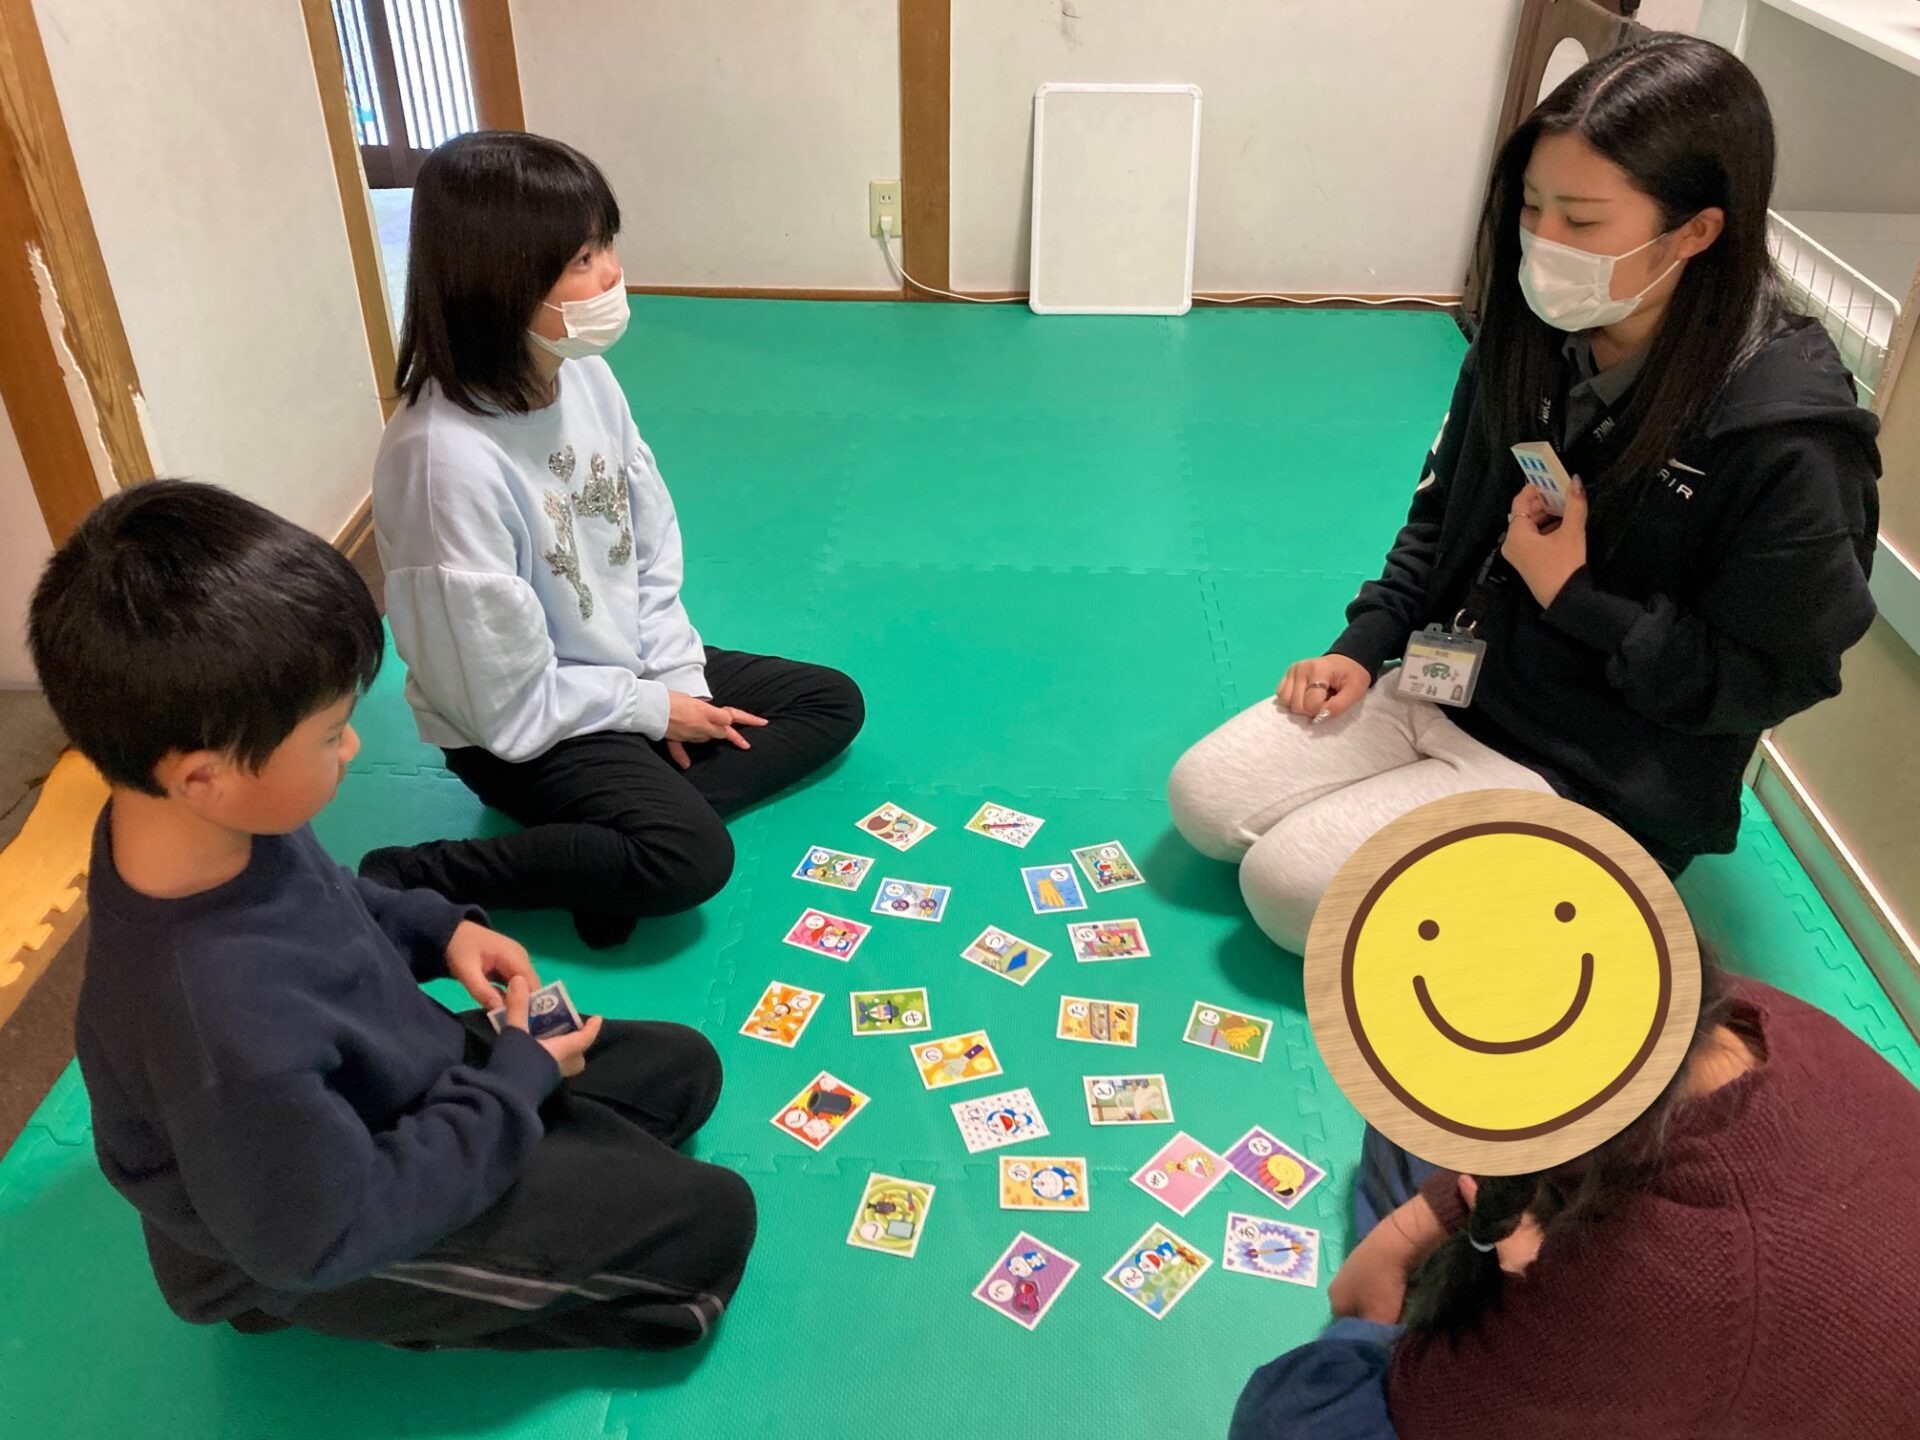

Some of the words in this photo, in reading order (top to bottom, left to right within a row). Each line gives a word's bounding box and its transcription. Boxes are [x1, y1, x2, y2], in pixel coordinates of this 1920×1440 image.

[1656, 468, 1694, 500] AIR
[1201, 1011, 1218, 1025] に
[1251, 1138, 1270, 1154] な
[1012, 1163, 1028, 1178] か
[1238, 1224, 1257, 1240] あ
[1123, 1267, 1143, 1286] え
[992, 1282, 1008, 1299] う
